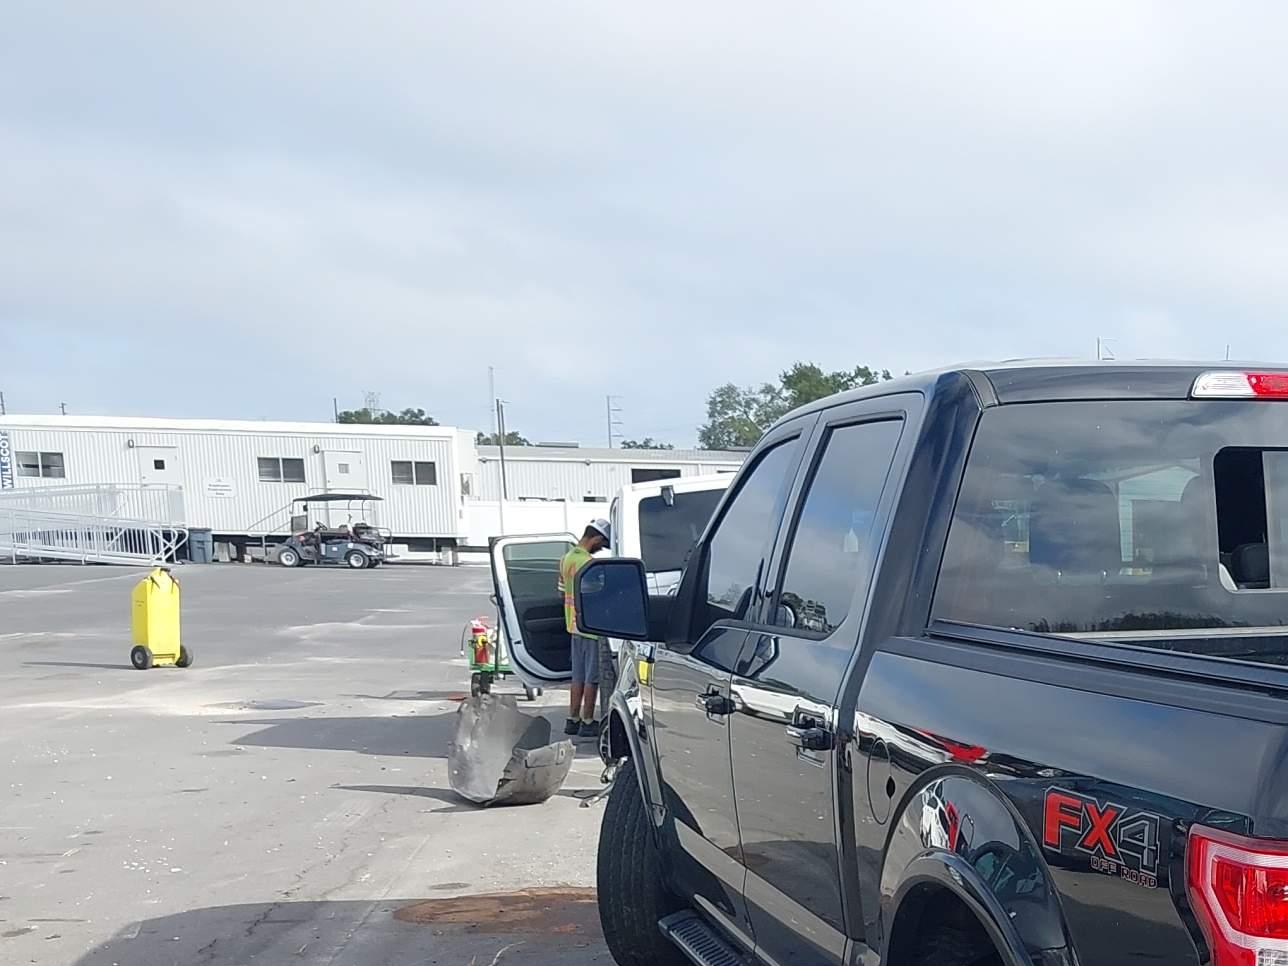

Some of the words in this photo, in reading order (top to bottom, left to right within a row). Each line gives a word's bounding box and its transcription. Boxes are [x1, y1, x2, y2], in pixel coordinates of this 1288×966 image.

[0, 432, 13, 489] WILLSCOT
[1043, 785, 1160, 876] FX4
[1090, 855, 1117, 874] OFF
[1120, 865, 1158, 889] ROAD
